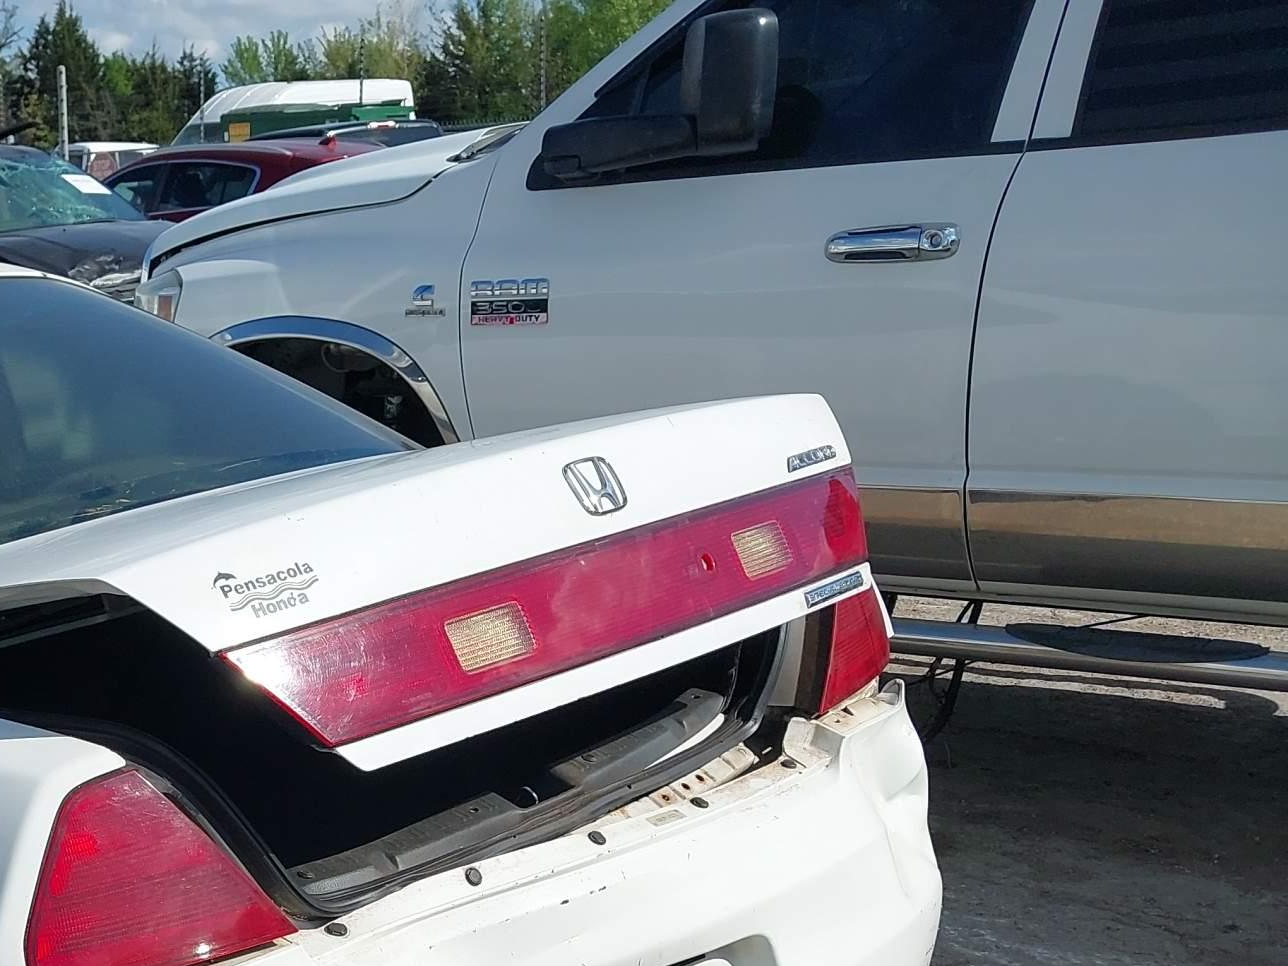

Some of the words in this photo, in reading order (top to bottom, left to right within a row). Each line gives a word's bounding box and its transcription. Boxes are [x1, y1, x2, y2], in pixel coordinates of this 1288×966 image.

[470, 278, 548, 297] RAM
[475, 301, 542, 314] 350
[515, 314, 541, 323] DUTY
[219, 561, 314, 599] Pensacola
[250, 591, 310, 618] Honda
